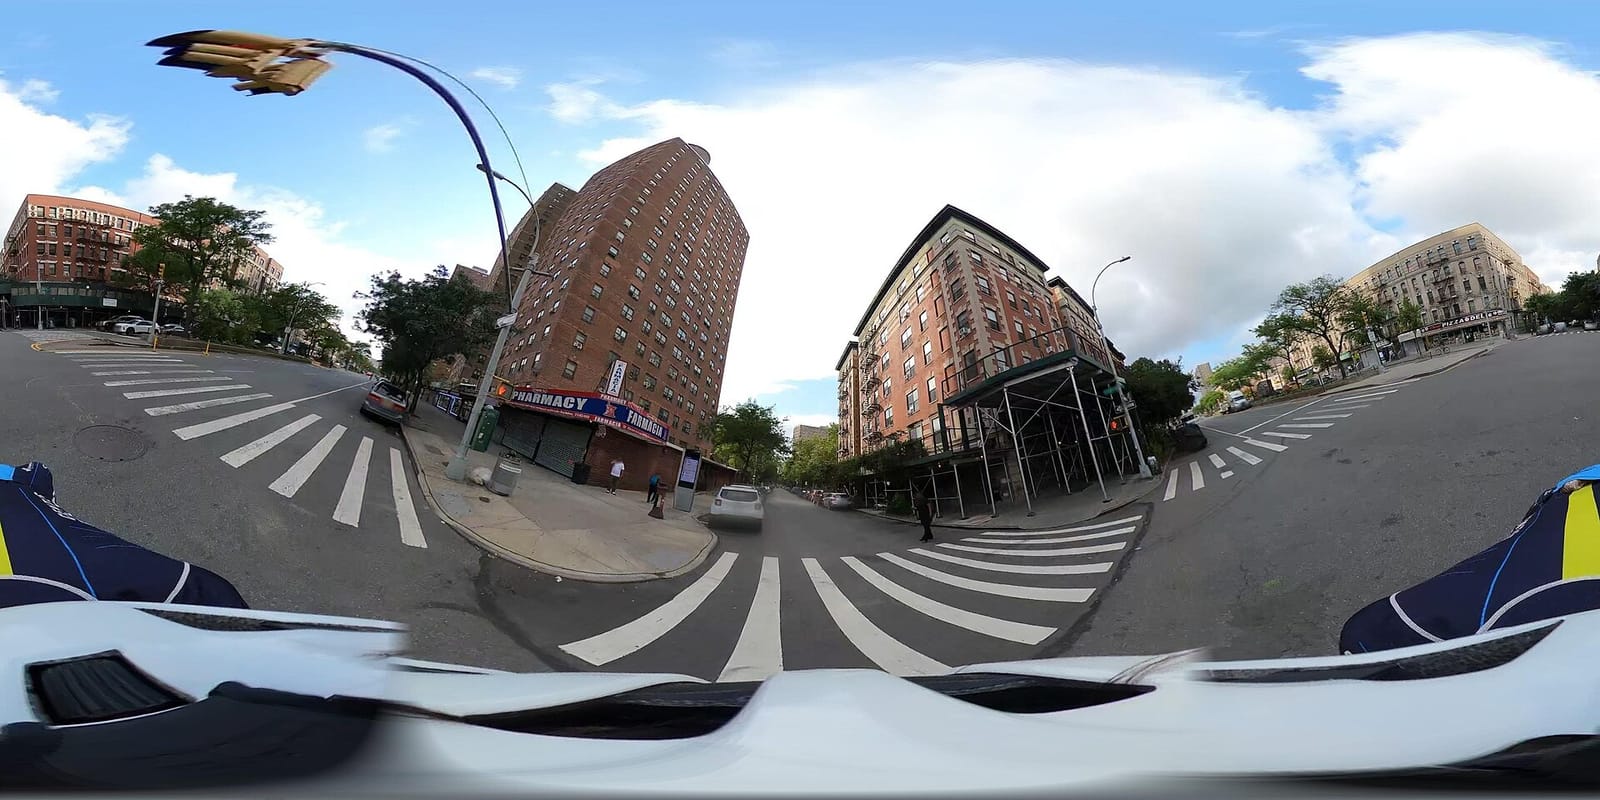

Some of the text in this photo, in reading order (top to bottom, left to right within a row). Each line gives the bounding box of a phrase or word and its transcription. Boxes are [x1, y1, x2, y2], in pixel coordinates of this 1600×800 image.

[610, 364, 623, 393] FARMACIA
[512, 391, 588, 411] PHARMACY
[594, 416, 622, 428] FARMACIA
[627, 410, 663, 438] FARMACIA
